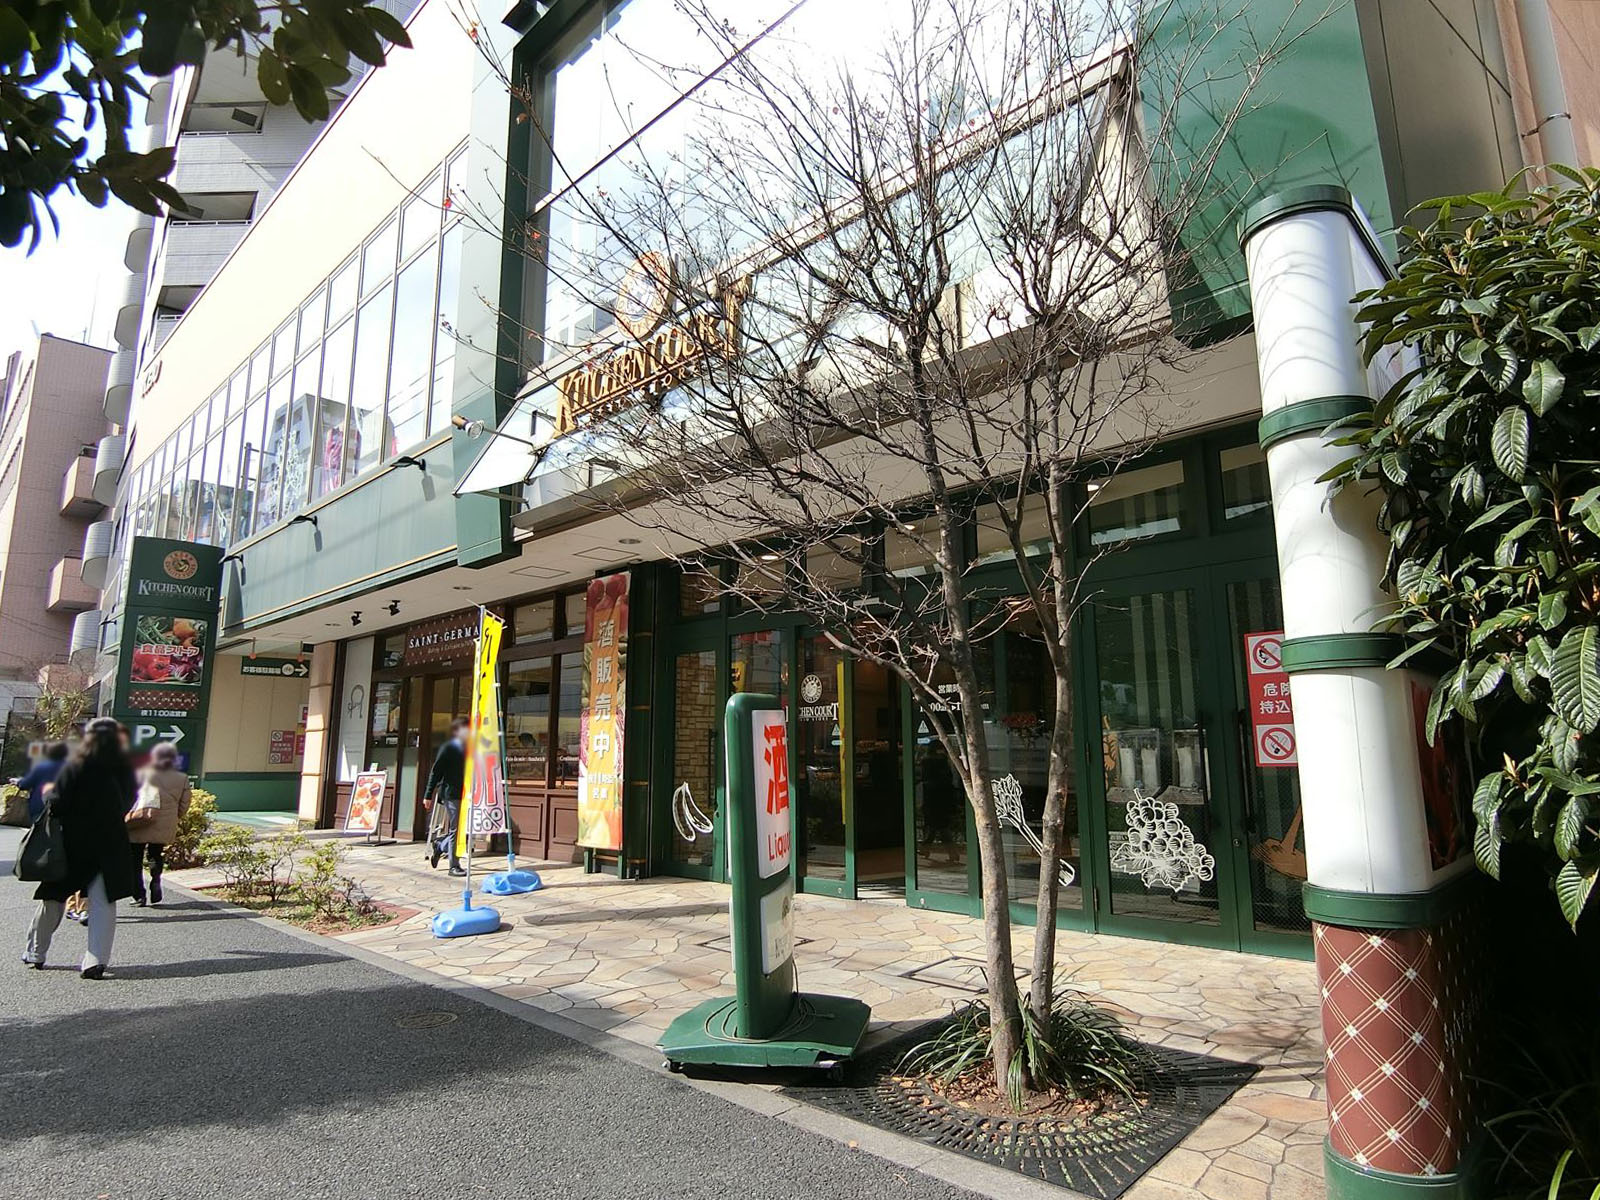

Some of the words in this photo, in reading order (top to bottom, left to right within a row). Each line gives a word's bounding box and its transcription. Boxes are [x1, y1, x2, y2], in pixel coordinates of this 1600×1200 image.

[141, 643, 200, 657] 食品ストア
[134, 724, 157, 747] P
[763, 724, 789, 815] 酒
